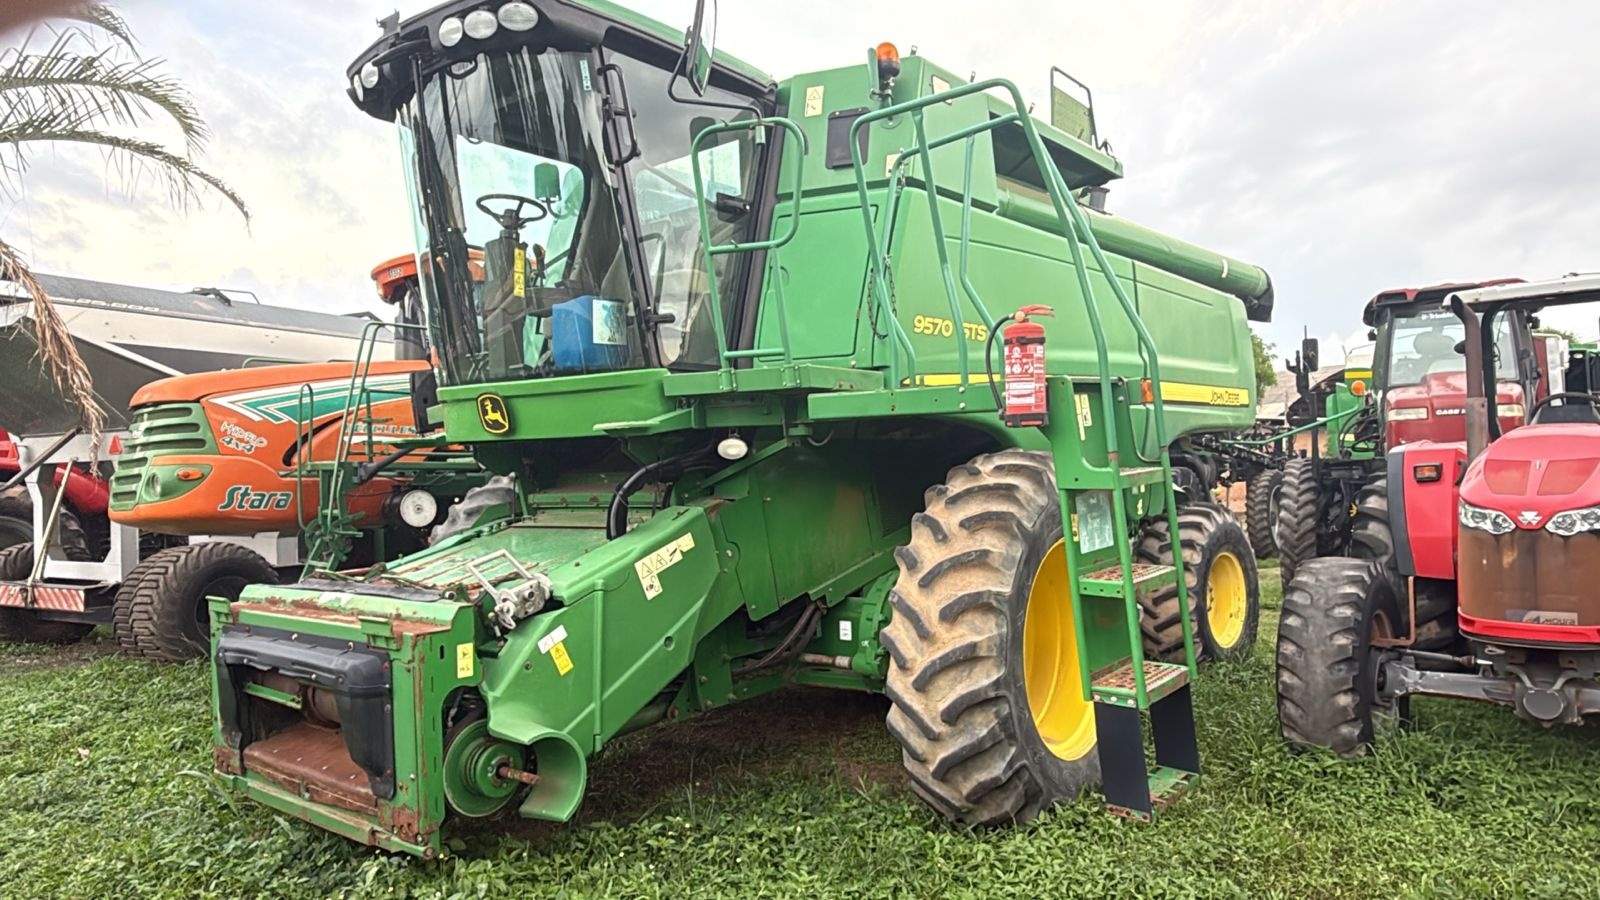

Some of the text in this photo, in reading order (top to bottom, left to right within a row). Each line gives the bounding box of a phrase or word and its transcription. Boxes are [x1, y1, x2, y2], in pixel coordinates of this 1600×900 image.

[913, 315, 953, 338] 9570
[1210, 389, 1240, 404] JOHN DEERE
[1435, 408, 1460, 418] CASE
[218, 484, 293, 511] Stara
